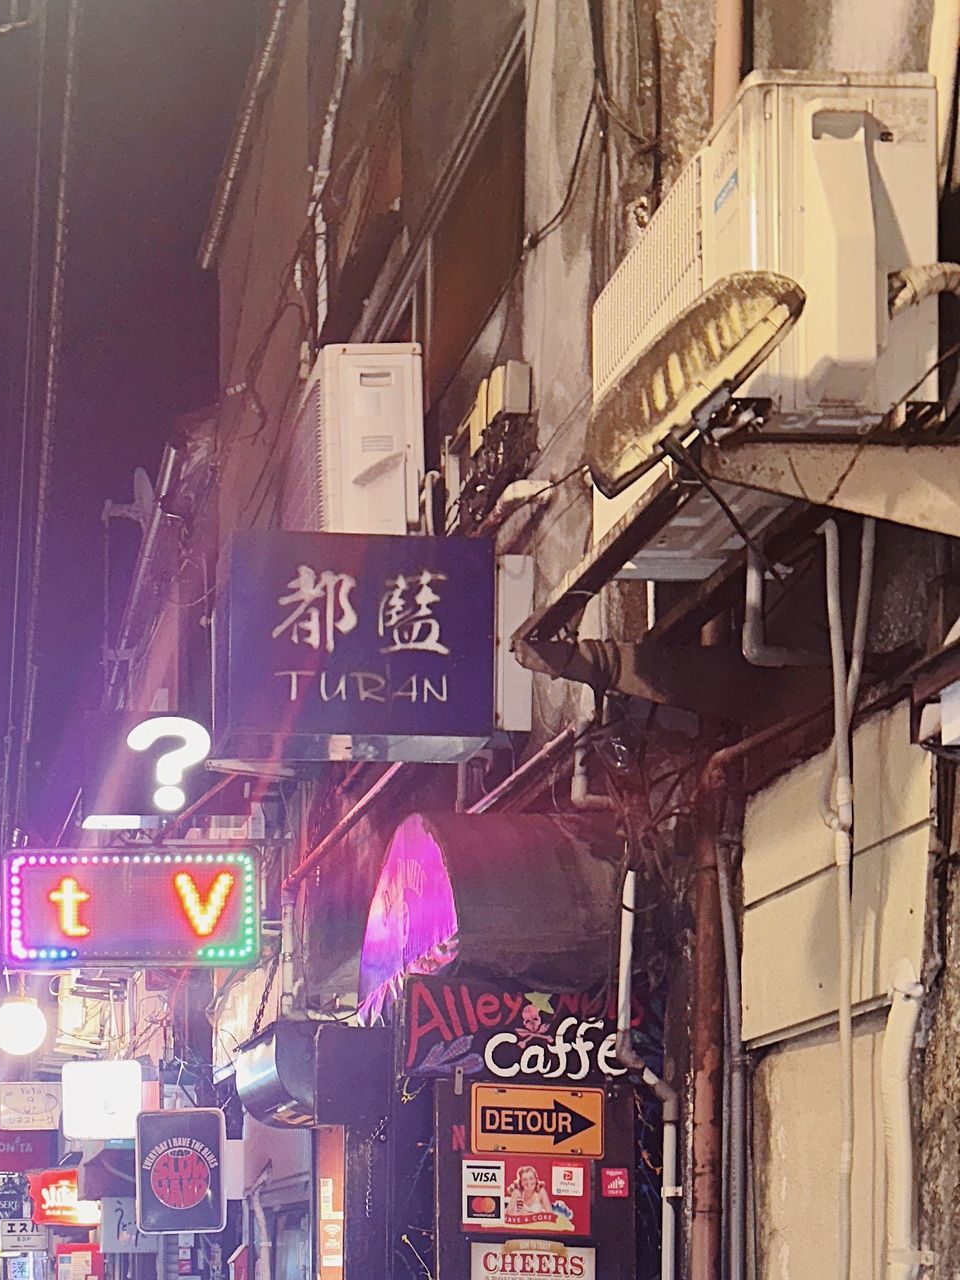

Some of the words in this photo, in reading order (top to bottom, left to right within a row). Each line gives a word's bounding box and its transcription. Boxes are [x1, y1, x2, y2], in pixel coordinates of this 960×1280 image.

[274, 670, 448, 702] TURAN
[406, 981, 522, 1068] Alley
[486, 1110, 572, 1133] DETOUR
[142, 1139, 170, 1170] EVERYDAY
[173, 1138, 190, 1147] HAVE
[191, 1139, 204, 1153] THE
[201, 1144, 219, 1168] BLUES
[472, 1172, 497, 1182] VISA
[533, 1214, 552, 1222] COKE
[483, 1252, 584, 1276] CHEERS
